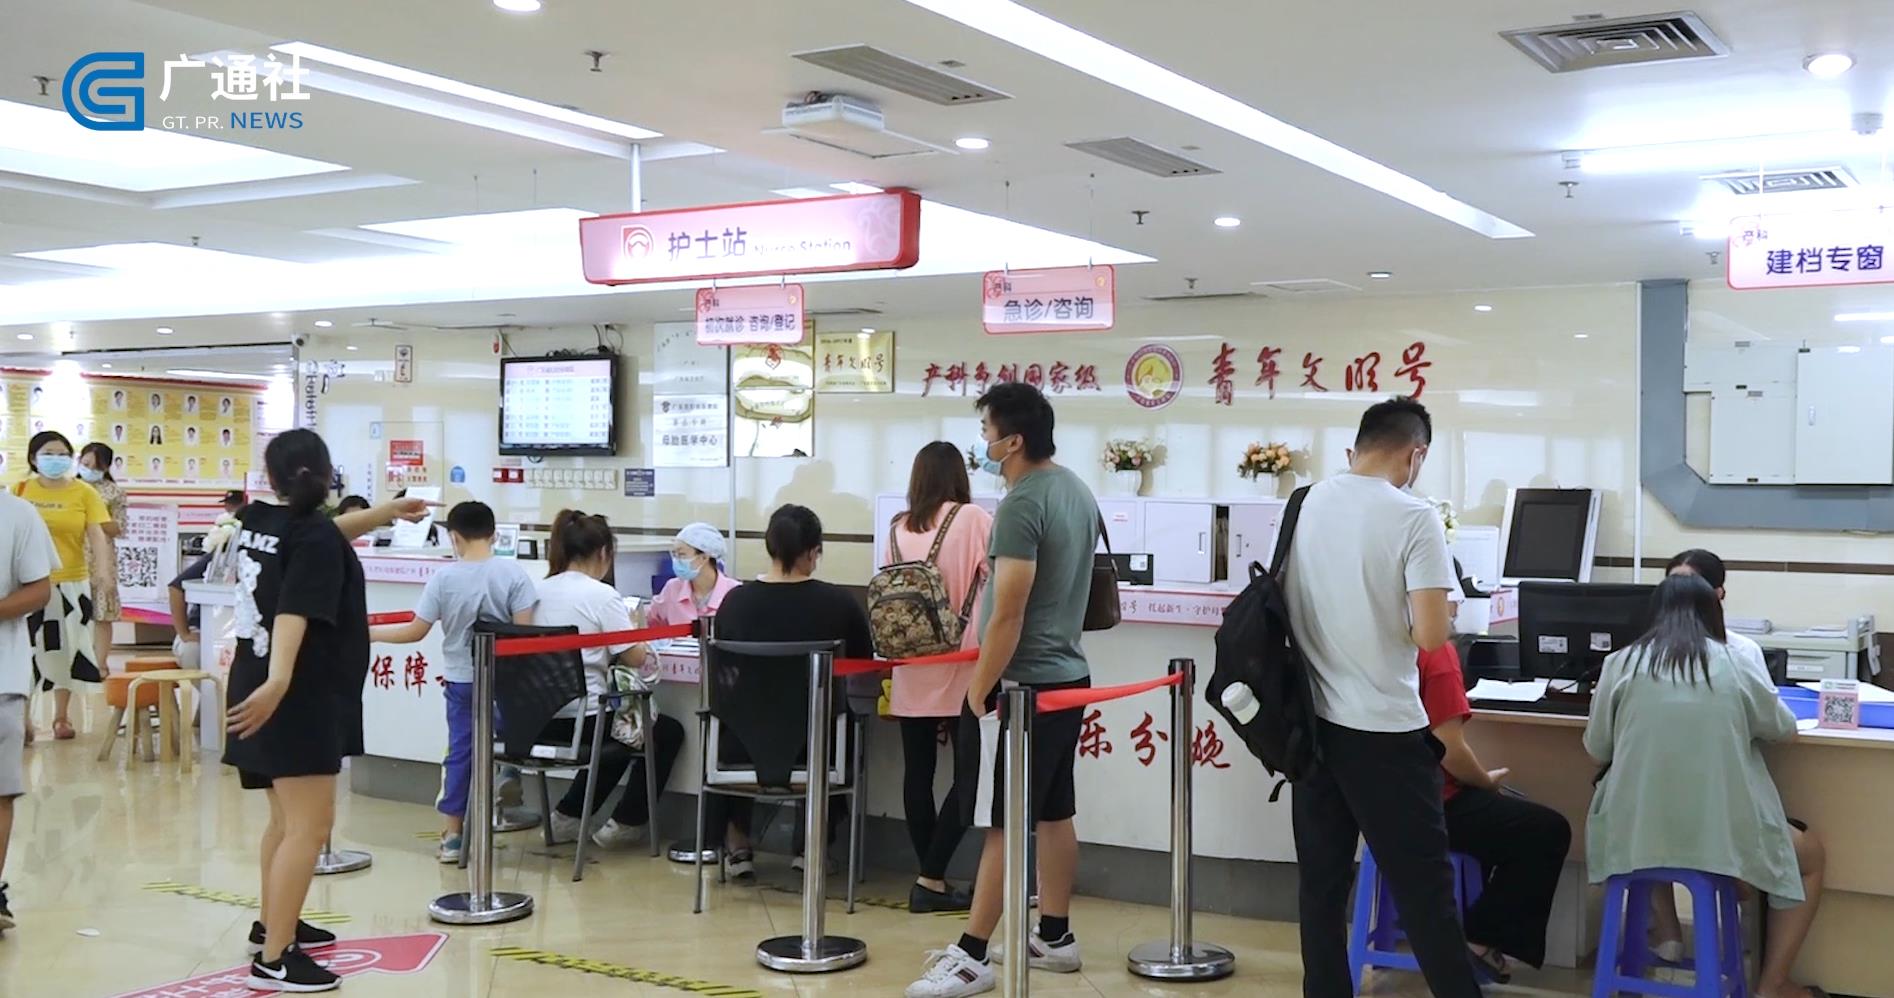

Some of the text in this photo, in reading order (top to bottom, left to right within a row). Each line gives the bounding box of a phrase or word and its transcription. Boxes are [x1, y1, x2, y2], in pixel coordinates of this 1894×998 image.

[667, 226, 748, 262] 护士站
[1766, 244, 1884, 275] 建档专窗
[1004, 296, 1094, 322] 急诊/咨询
[1208, 342, 1432, 406] 青年文明号
